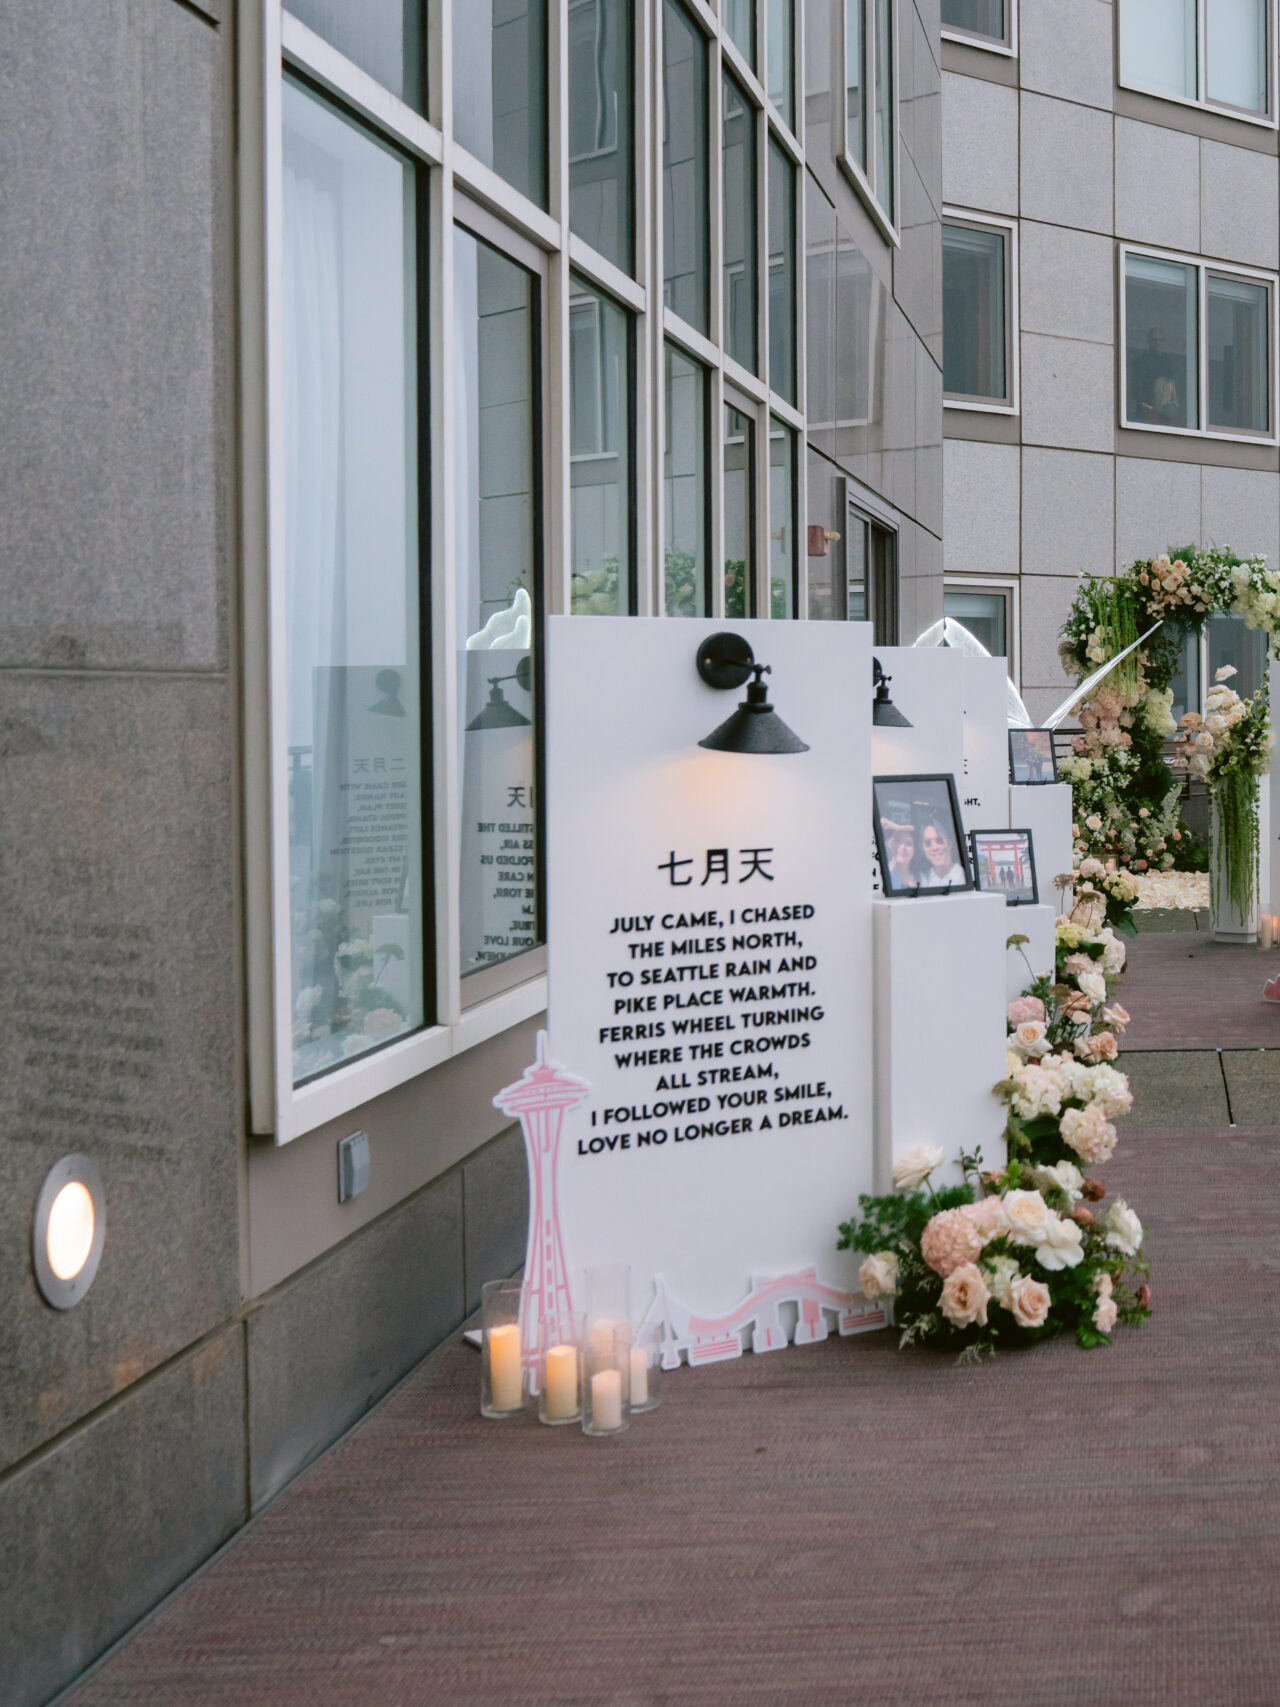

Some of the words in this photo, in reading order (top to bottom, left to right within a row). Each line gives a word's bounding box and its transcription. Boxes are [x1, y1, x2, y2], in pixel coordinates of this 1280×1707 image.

[657, 847, 775, 887] 七月天
[609, 915, 655, 934] JULY
[661, 910, 724, 930] CAME,
[730, 909, 735, 925] I
[740, 904, 815, 924] CHASED
[628, 941, 665, 960] THE
[671, 936, 727, 956] MILES
[732, 930, 803, 951] NORTH,
[606, 971, 634, 989] TO
[640, 963, 719, 986] SEATTLE
[725, 959, 771, 978] RAIN
[777, 955, 817, 974] AND
[614, 995, 657, 1015] PIKE
[663, 989, 724, 1010] PLACE
[728, 981, 816, 1003] WARMTH.
[599, 1021, 666, 1044] FERRIS
[671, 1015, 736, 1035] WHEEL
[740, 1005, 825, 1029] TURNING
[614, 1046, 683, 1069] WHERE
[688, 1041, 724, 1061] THE
[729, 1032, 811, 1056] CROWDS
[655, 1072, 692, 1092] ALL
[697, 1062, 779, 1086] STREAM,
[591, 1110, 597, 1127] I
[603, 1096, 711, 1125] FOLLOWED
[716, 1089, 768, 1110] YOUR
[774, 1081, 832, 1103] SMILE,
[577, 1133, 631, 1156] LOVE
[637, 1128, 668, 1148] NO
[674, 1117, 753, 1143] LONGER
[759, 1114, 773, 1131] A
[778, 1105, 849, 1128] DREAM.
